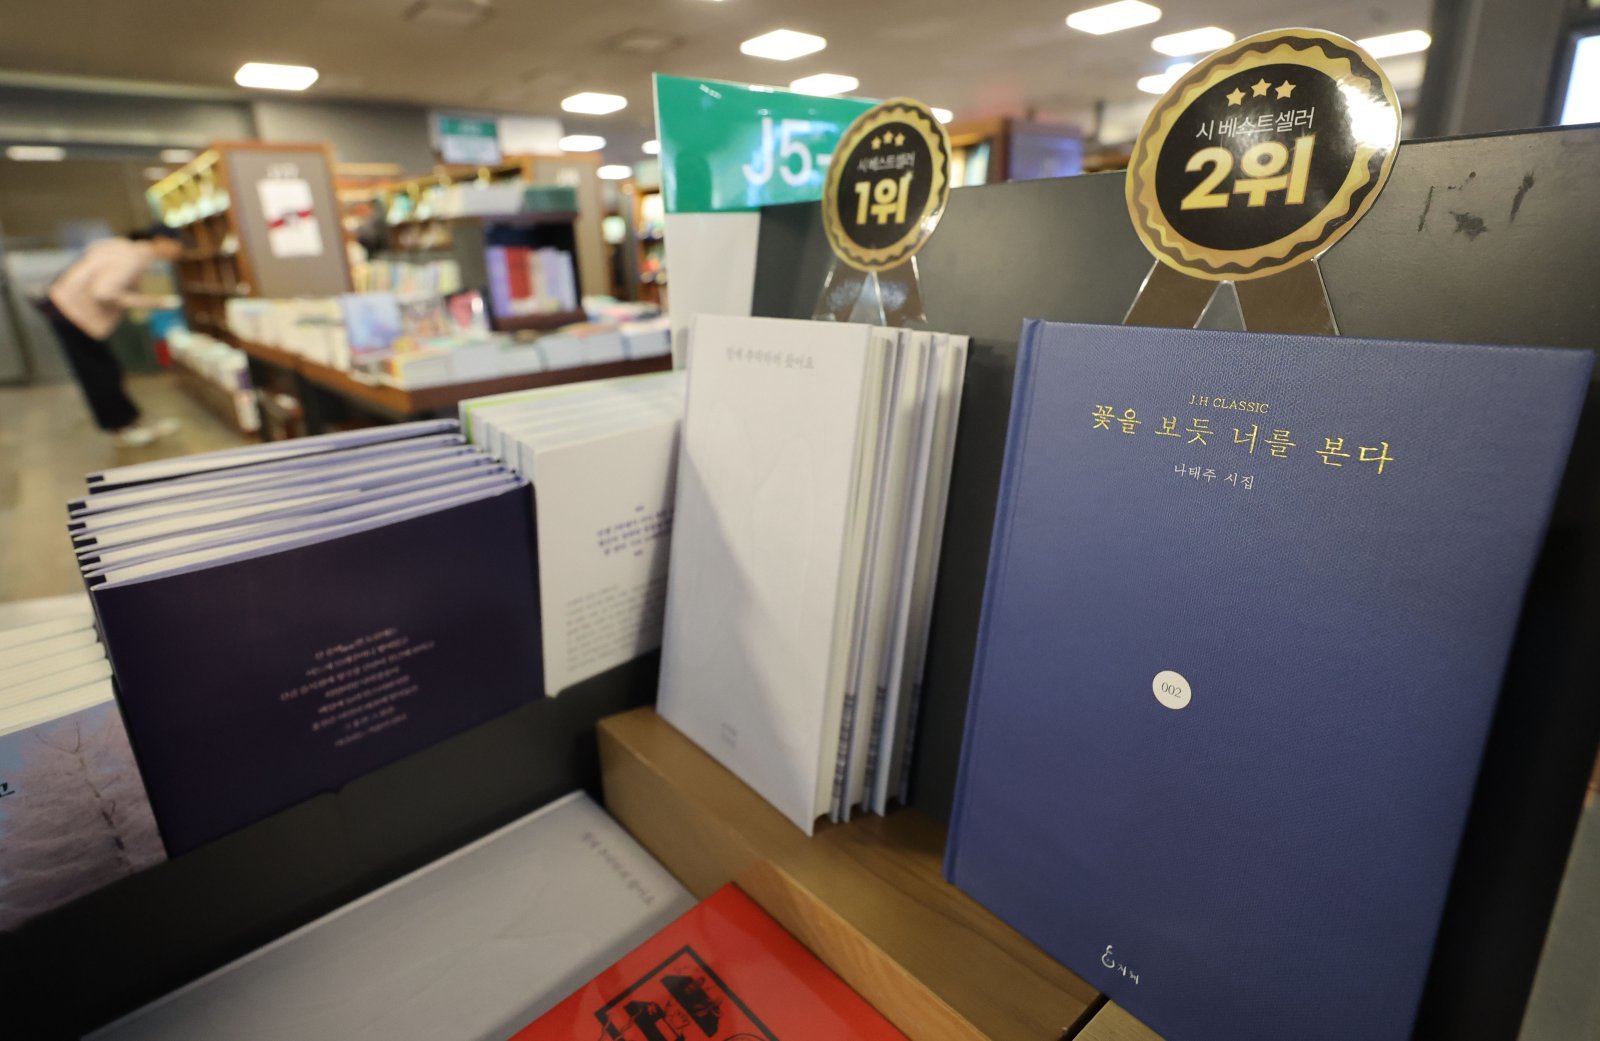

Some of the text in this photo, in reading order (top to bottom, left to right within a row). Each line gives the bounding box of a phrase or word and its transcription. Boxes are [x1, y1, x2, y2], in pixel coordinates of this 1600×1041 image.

[1196, 107, 1315, 140] 시 베스트셀러
[1180, 134, 1316, 211] 2위
[854, 170, 914, 225] 1위
[1189, 394, 1269, 414] J.H CLASSIC
[1092, 404, 1394, 475] 꽃을 보듯 너를 본다
[1174, 463, 1255, 490] 나태주 시집
[1161, 681, 1182, 698] 002
